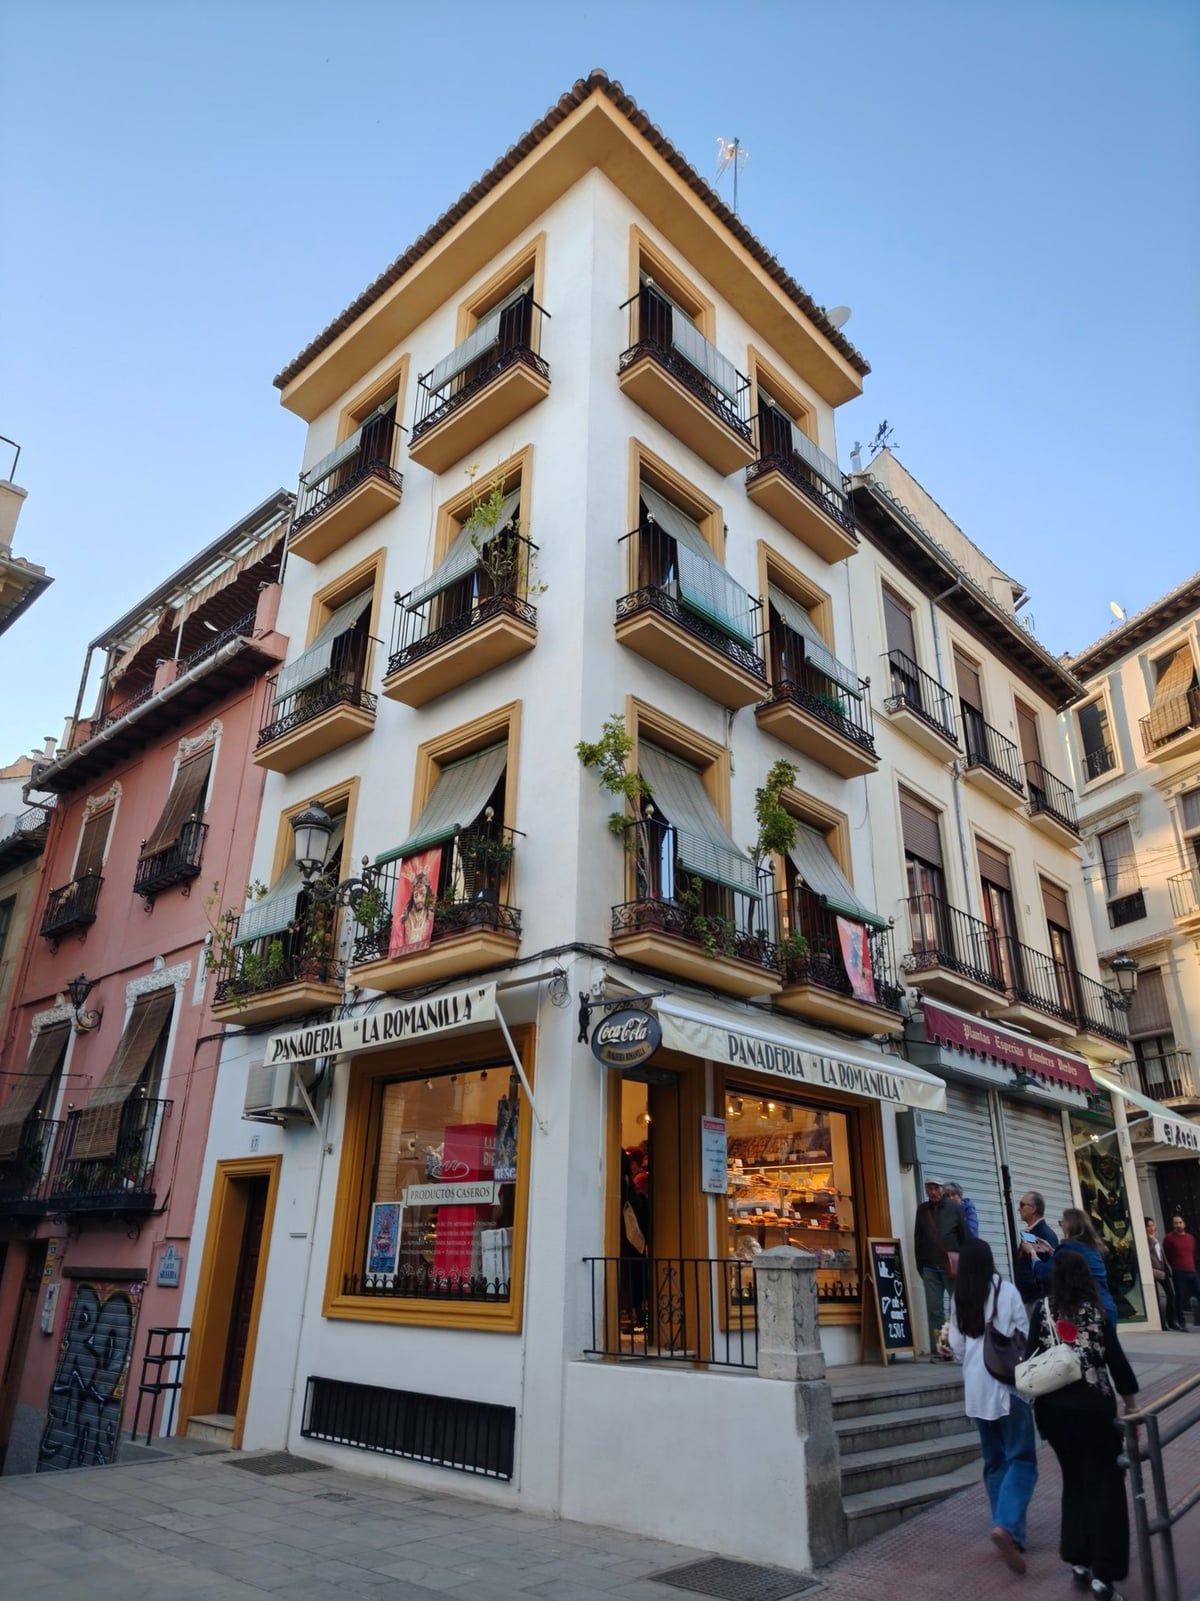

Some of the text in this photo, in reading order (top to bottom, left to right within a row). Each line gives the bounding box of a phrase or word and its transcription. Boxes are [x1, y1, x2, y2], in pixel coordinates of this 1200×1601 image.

[272, 1024, 342, 1062] PANADERIA
[962, 1023, 991, 1045] Plantas
[727, 1035, 805, 1079] PANADERIA
[410, 1186, 490, 1200] PRODUCTOS CASEROS
